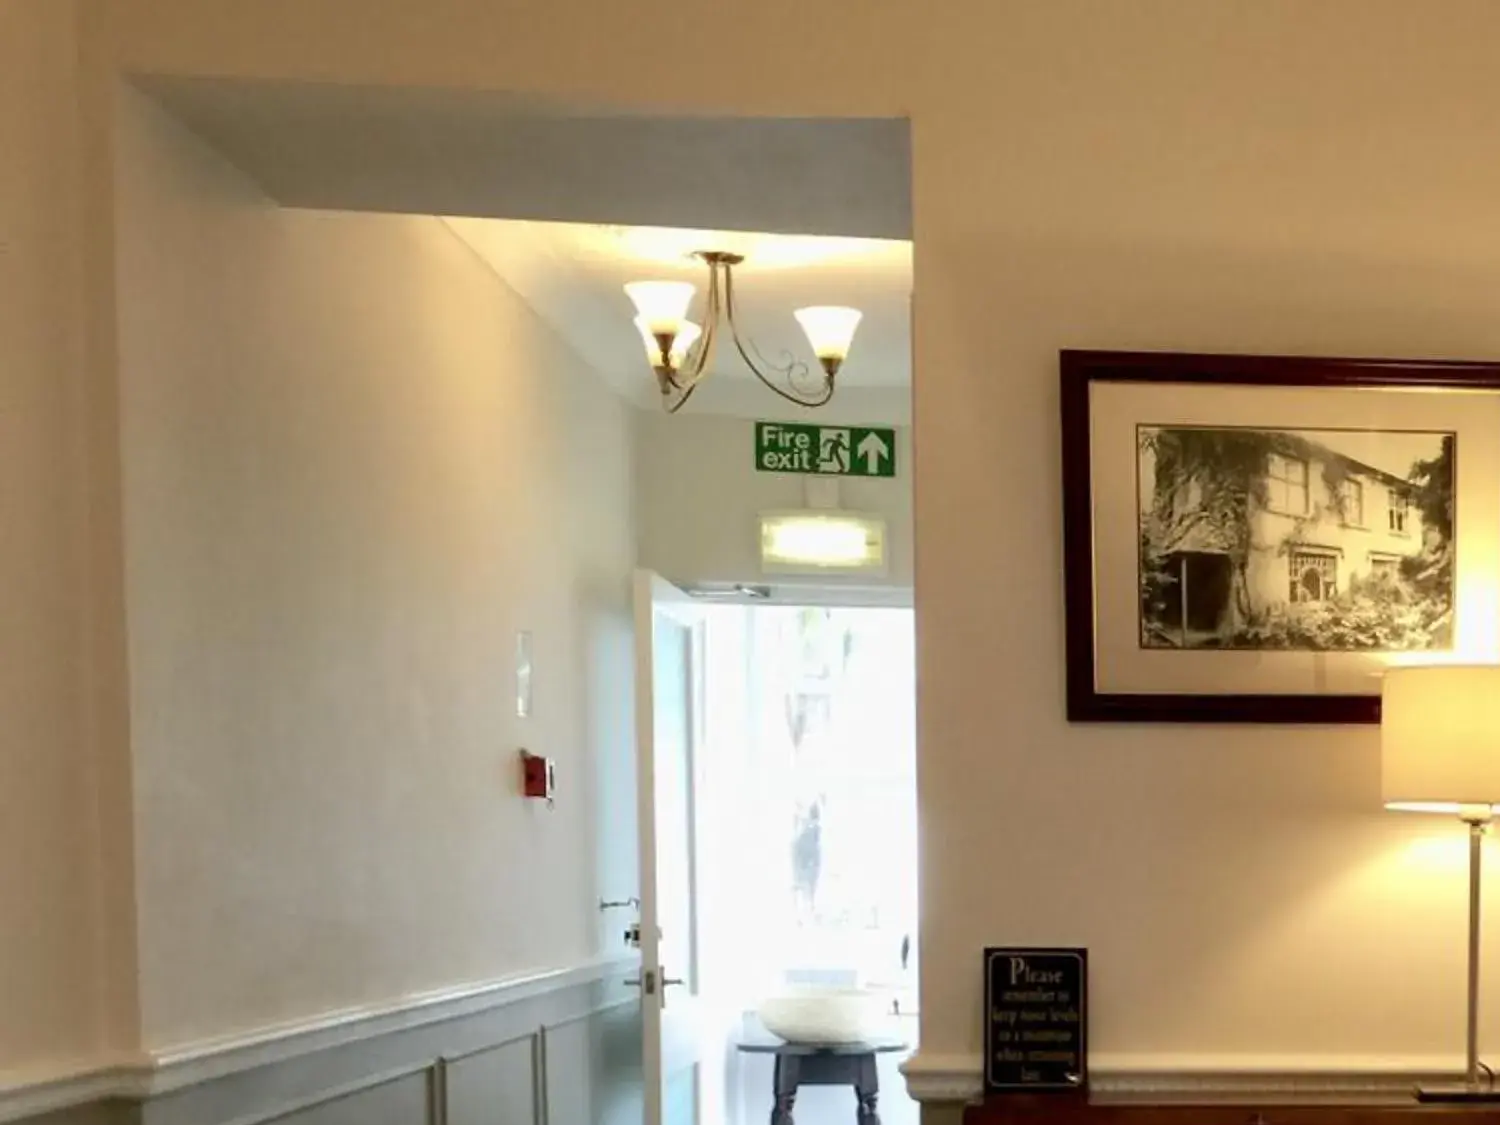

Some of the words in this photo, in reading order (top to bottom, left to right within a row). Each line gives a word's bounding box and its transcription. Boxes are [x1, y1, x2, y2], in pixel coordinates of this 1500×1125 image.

[762, 426, 811, 448] Fire
[762, 449, 811, 470] exit
[1010, 957, 1064, 985] Please
